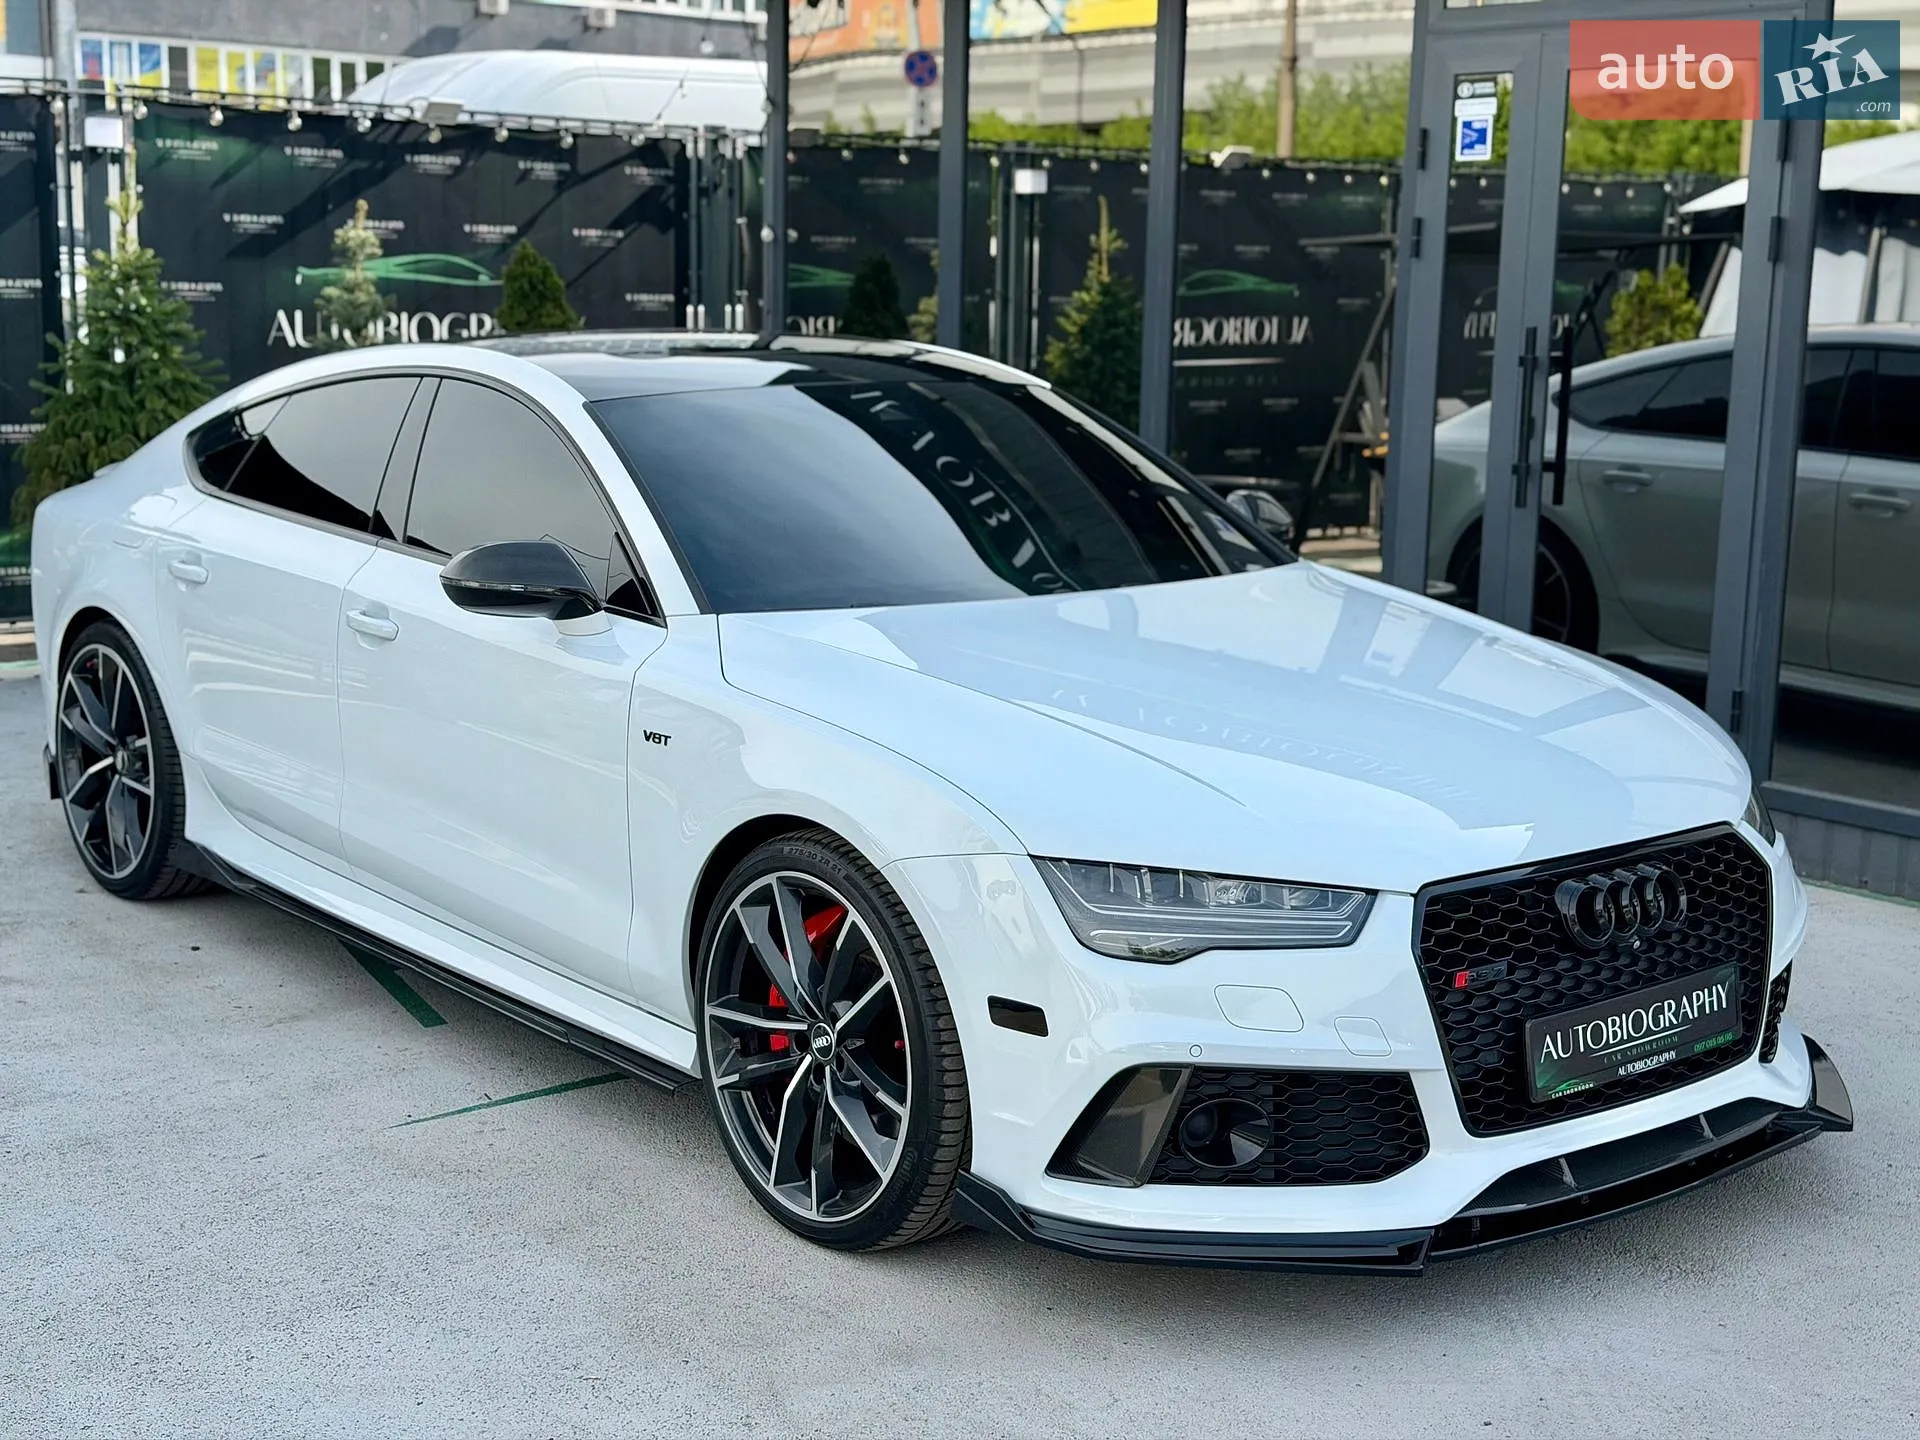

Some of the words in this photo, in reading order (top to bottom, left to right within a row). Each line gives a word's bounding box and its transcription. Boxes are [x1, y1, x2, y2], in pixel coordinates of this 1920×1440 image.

[643, 729, 672, 746] V8T
[1540, 981, 1730, 1064] AUTOBIOGRAPHY
[1617, 1049, 1677, 1077] AUTOBIOGRAPHY
